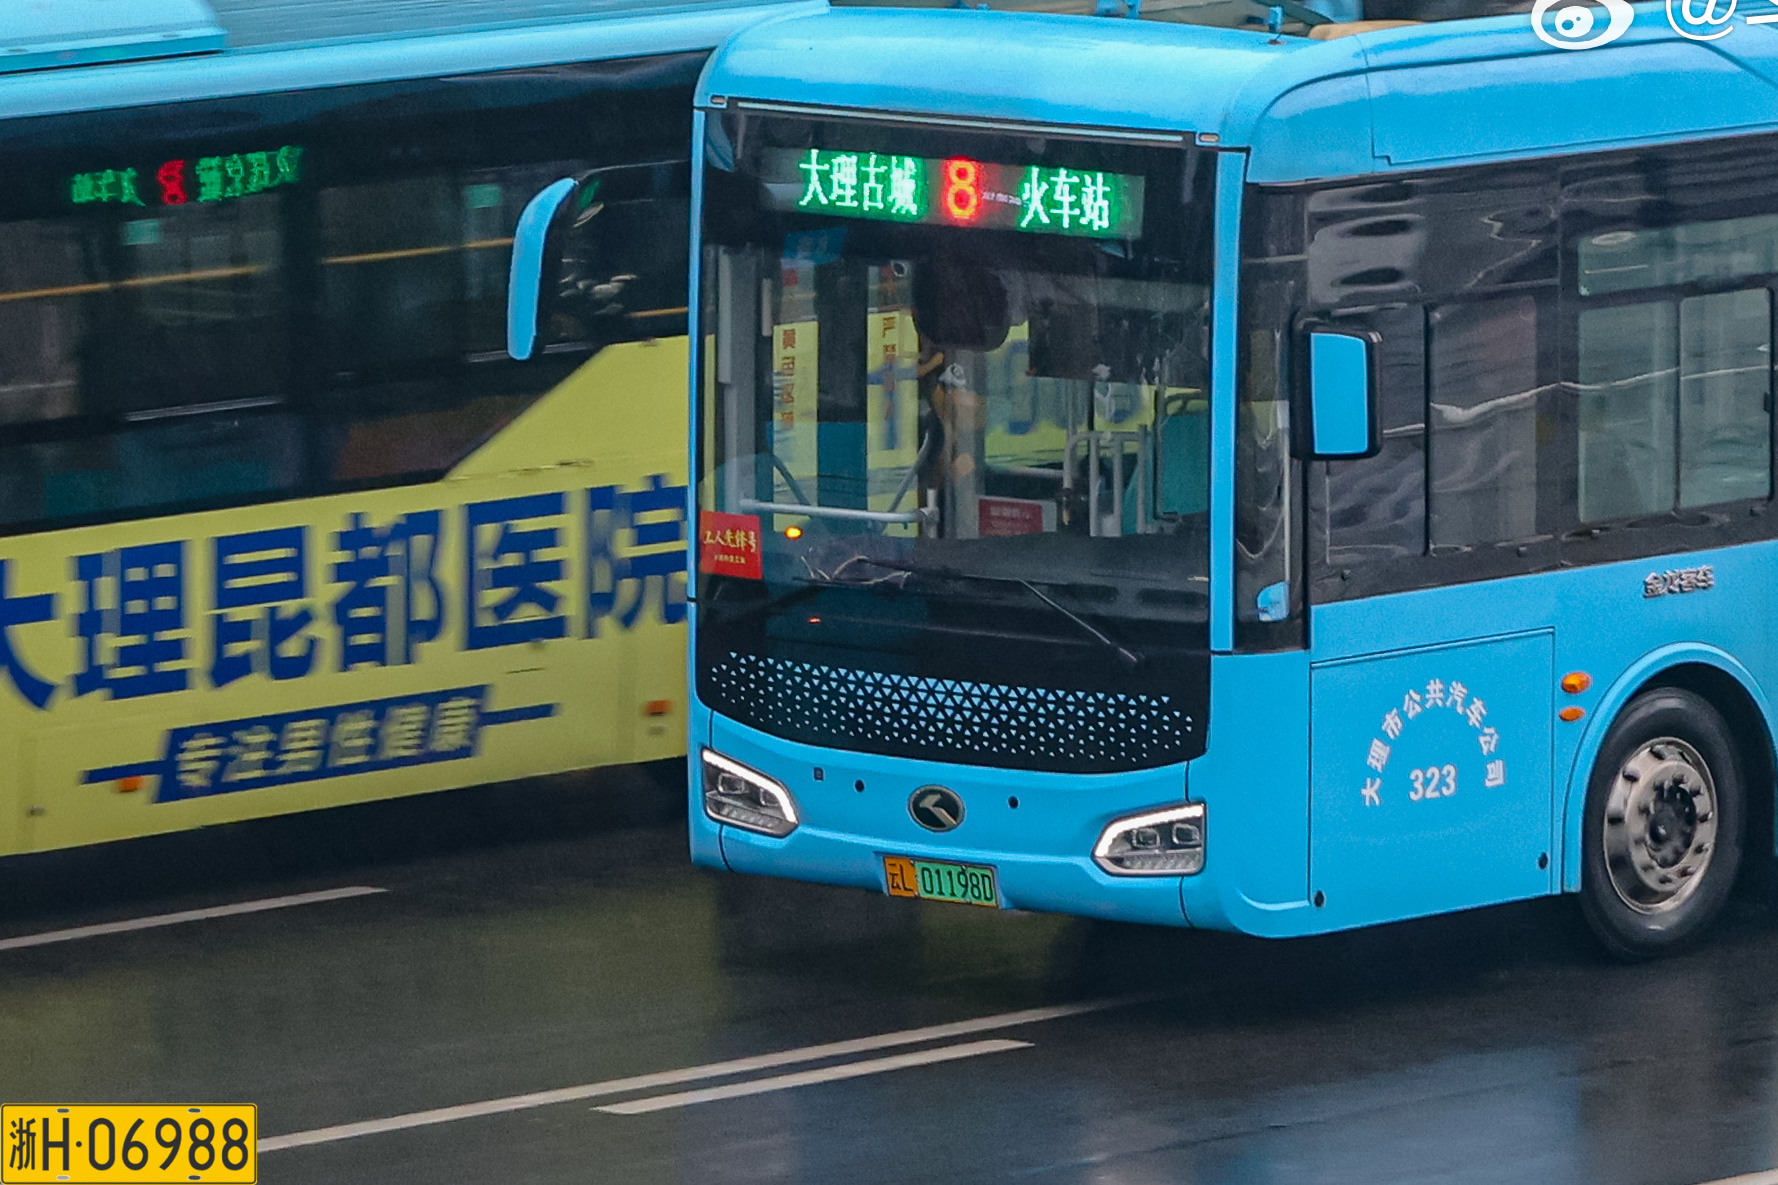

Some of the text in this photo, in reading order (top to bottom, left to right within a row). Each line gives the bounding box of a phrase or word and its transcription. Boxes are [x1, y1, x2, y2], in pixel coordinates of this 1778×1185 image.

[799, 148, 1112, 231] 大理古城 8 火车站
[703, 527, 758, 554] 工人先锋号
[174, 695, 482, 790] 专注男性健康
[1360, 678, 1507, 807] 大理市公共汽车公司
[1408, 763, 1458, 803] 323
